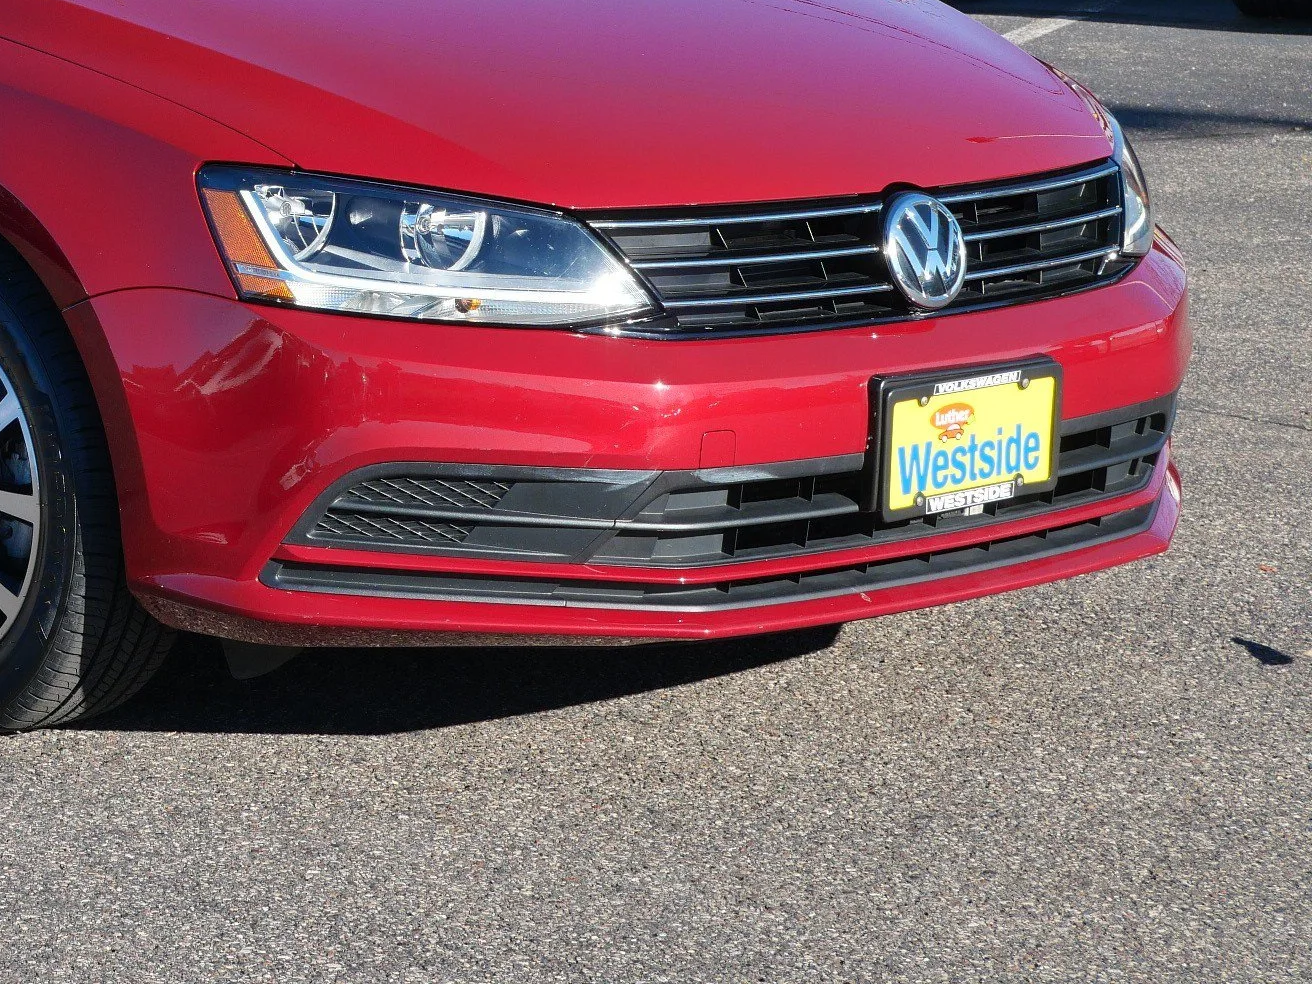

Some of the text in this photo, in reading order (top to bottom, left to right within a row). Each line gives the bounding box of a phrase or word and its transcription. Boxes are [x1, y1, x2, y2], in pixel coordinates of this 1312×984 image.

[937, 371, 1020, 394] VOLKSWAGEN
[935, 407, 972, 427] Luther
[897, 423, 1041, 496] Westside
[928, 482, 1013, 513] WESTSIDE
